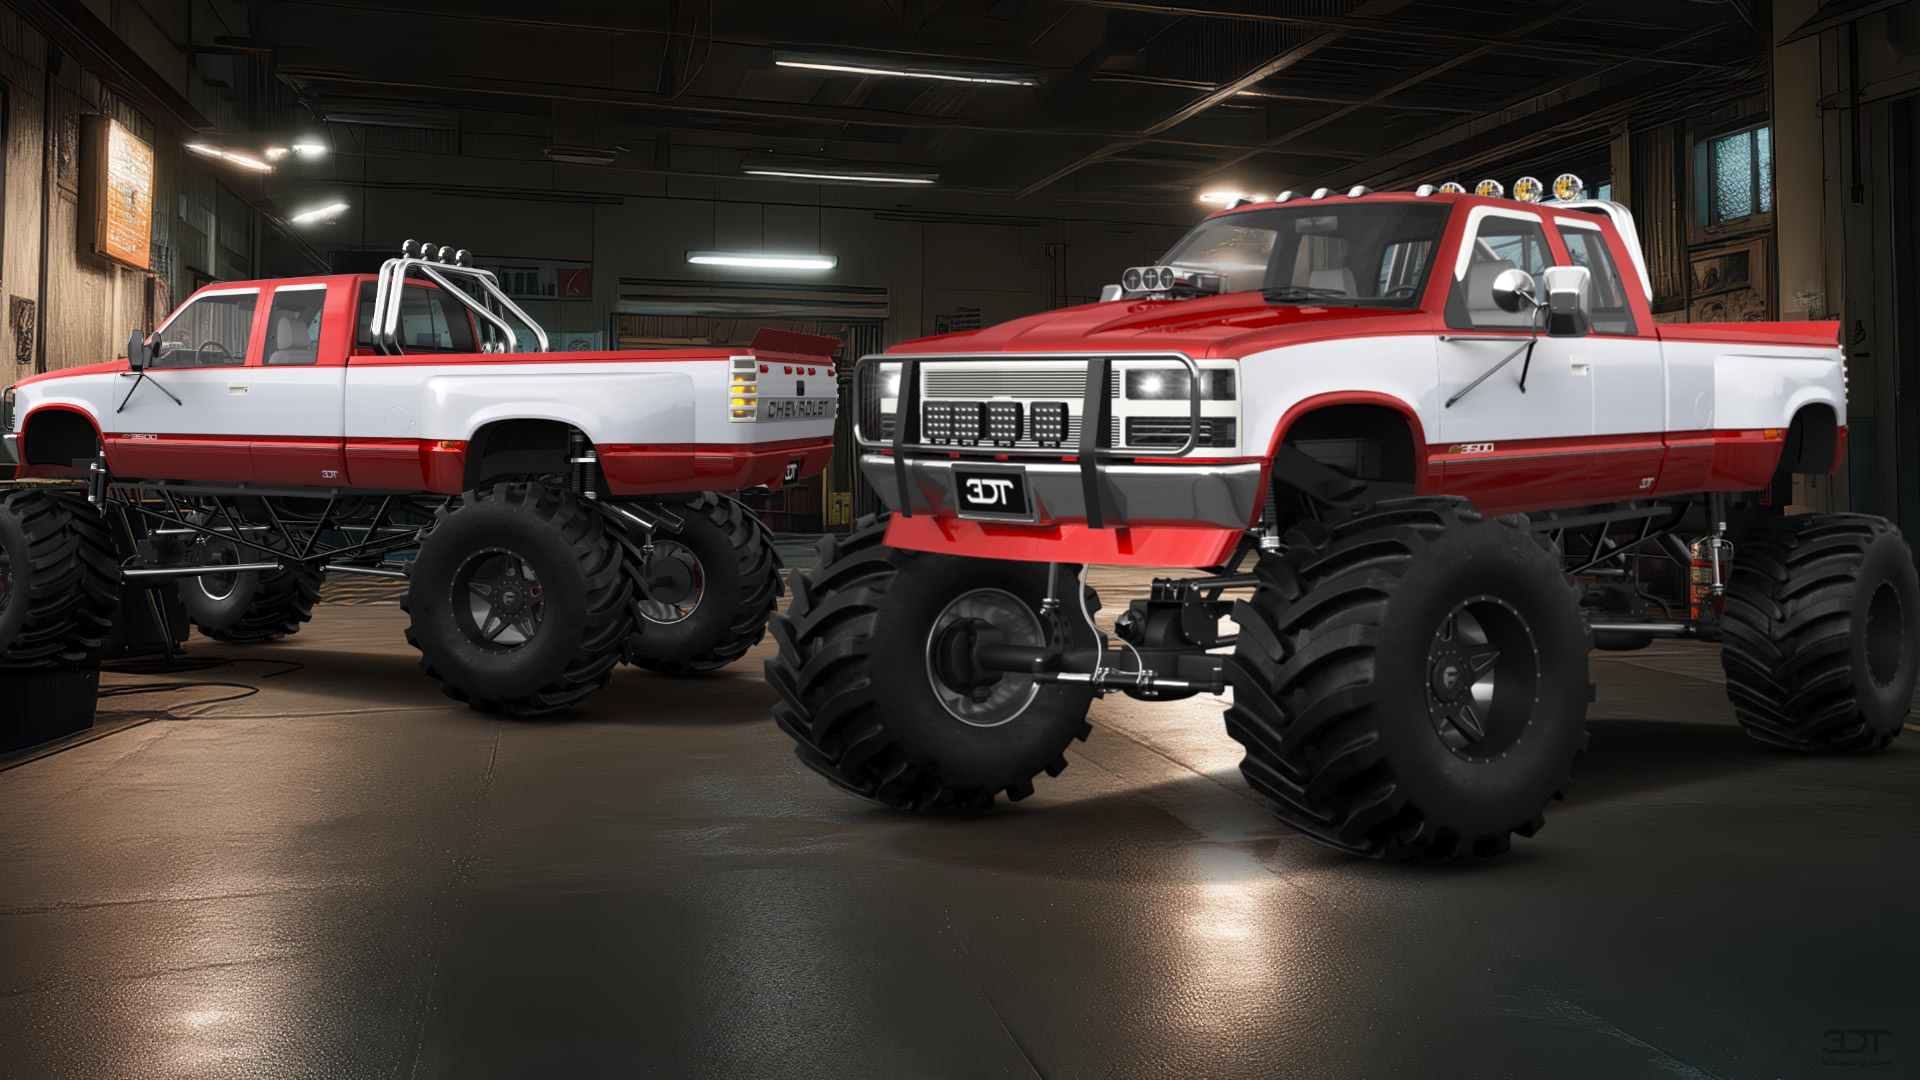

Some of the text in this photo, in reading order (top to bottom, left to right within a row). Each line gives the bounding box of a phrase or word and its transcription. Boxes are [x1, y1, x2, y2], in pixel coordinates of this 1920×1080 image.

[767, 400, 829, 419] CHEVROLET
[1460, 443, 1494, 454] 3500
[321, 470, 339, 479] 3DT
[966, 478, 1014, 505] 3DT
